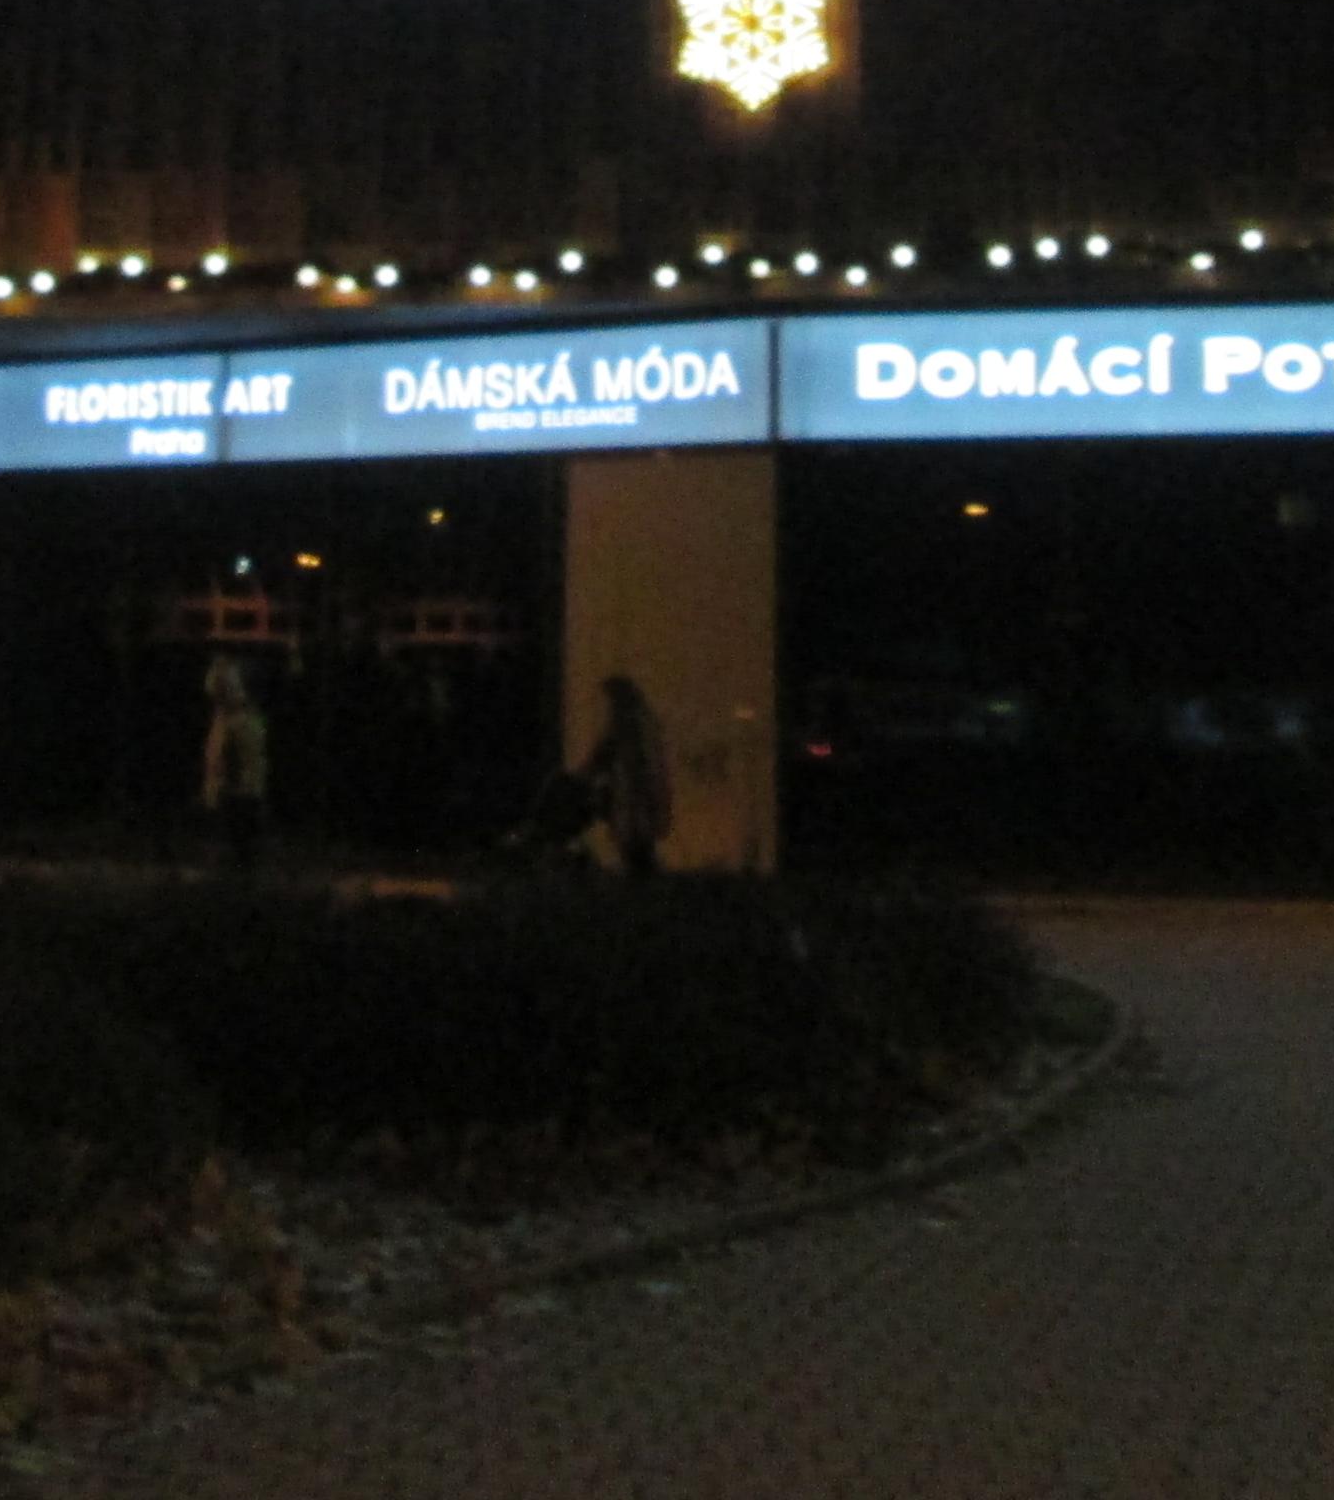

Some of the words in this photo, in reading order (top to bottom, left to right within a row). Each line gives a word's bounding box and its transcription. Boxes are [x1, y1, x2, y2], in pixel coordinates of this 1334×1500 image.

[45, 380, 213, 423] FLORISTIK
[223, 373, 292, 414] ART
[384, 352, 578, 414] DÁMSKÁ
[593, 345, 740, 403] MÓDA
